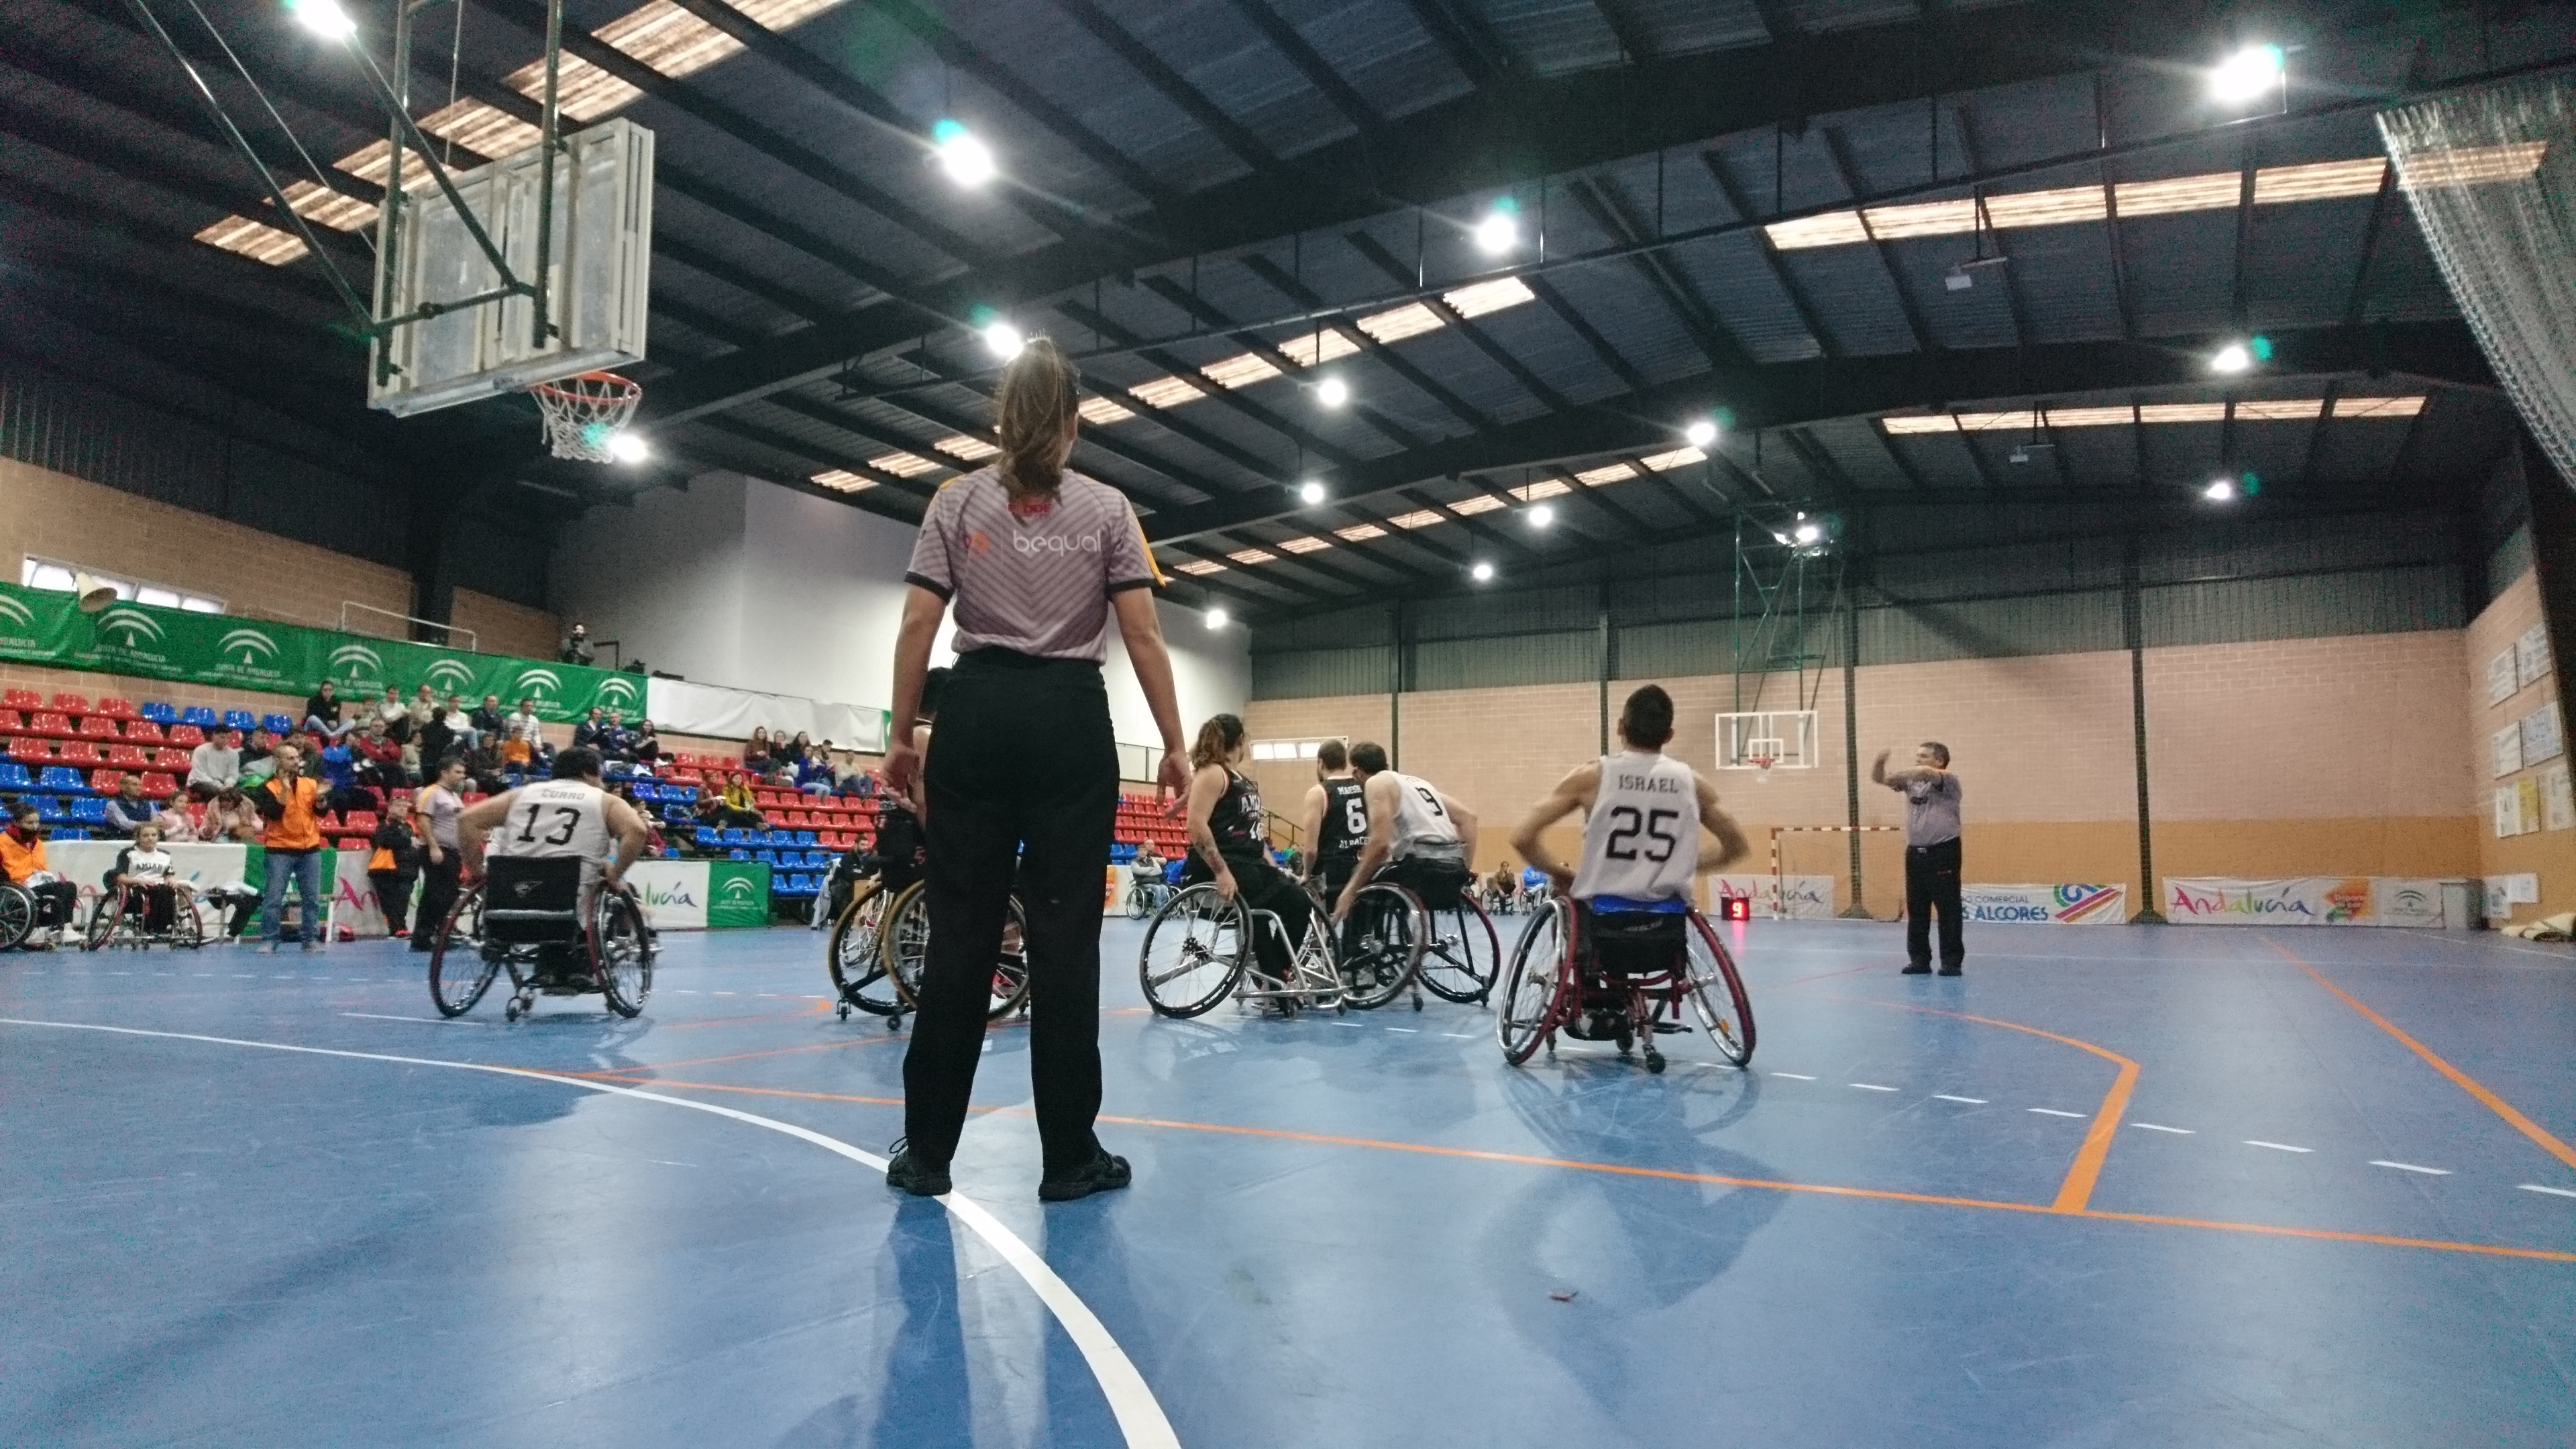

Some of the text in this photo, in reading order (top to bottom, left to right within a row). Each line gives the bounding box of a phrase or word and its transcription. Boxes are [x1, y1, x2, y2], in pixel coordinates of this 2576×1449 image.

[1013, 530, 1102, 557] bequal
[541, 788, 586, 800] CURRO
[1619, 774, 1678, 793] ISRAEL
[1415, 787, 1443, 816] 9
[517, 804, 581, 846] 13
[1346, 798, 1367, 834] 6
[1606, 806, 1679, 862] 25
[645, 881, 698, 908] lucía
[1719, 879, 1823, 904] Andaucía
[1974, 895, 2029, 904] COMERCIAL
[2171, 886, 2316, 916] Andalucía
[1732, 902, 1743, 917] 9
[1975, 906, 2049, 921] ALCORES
